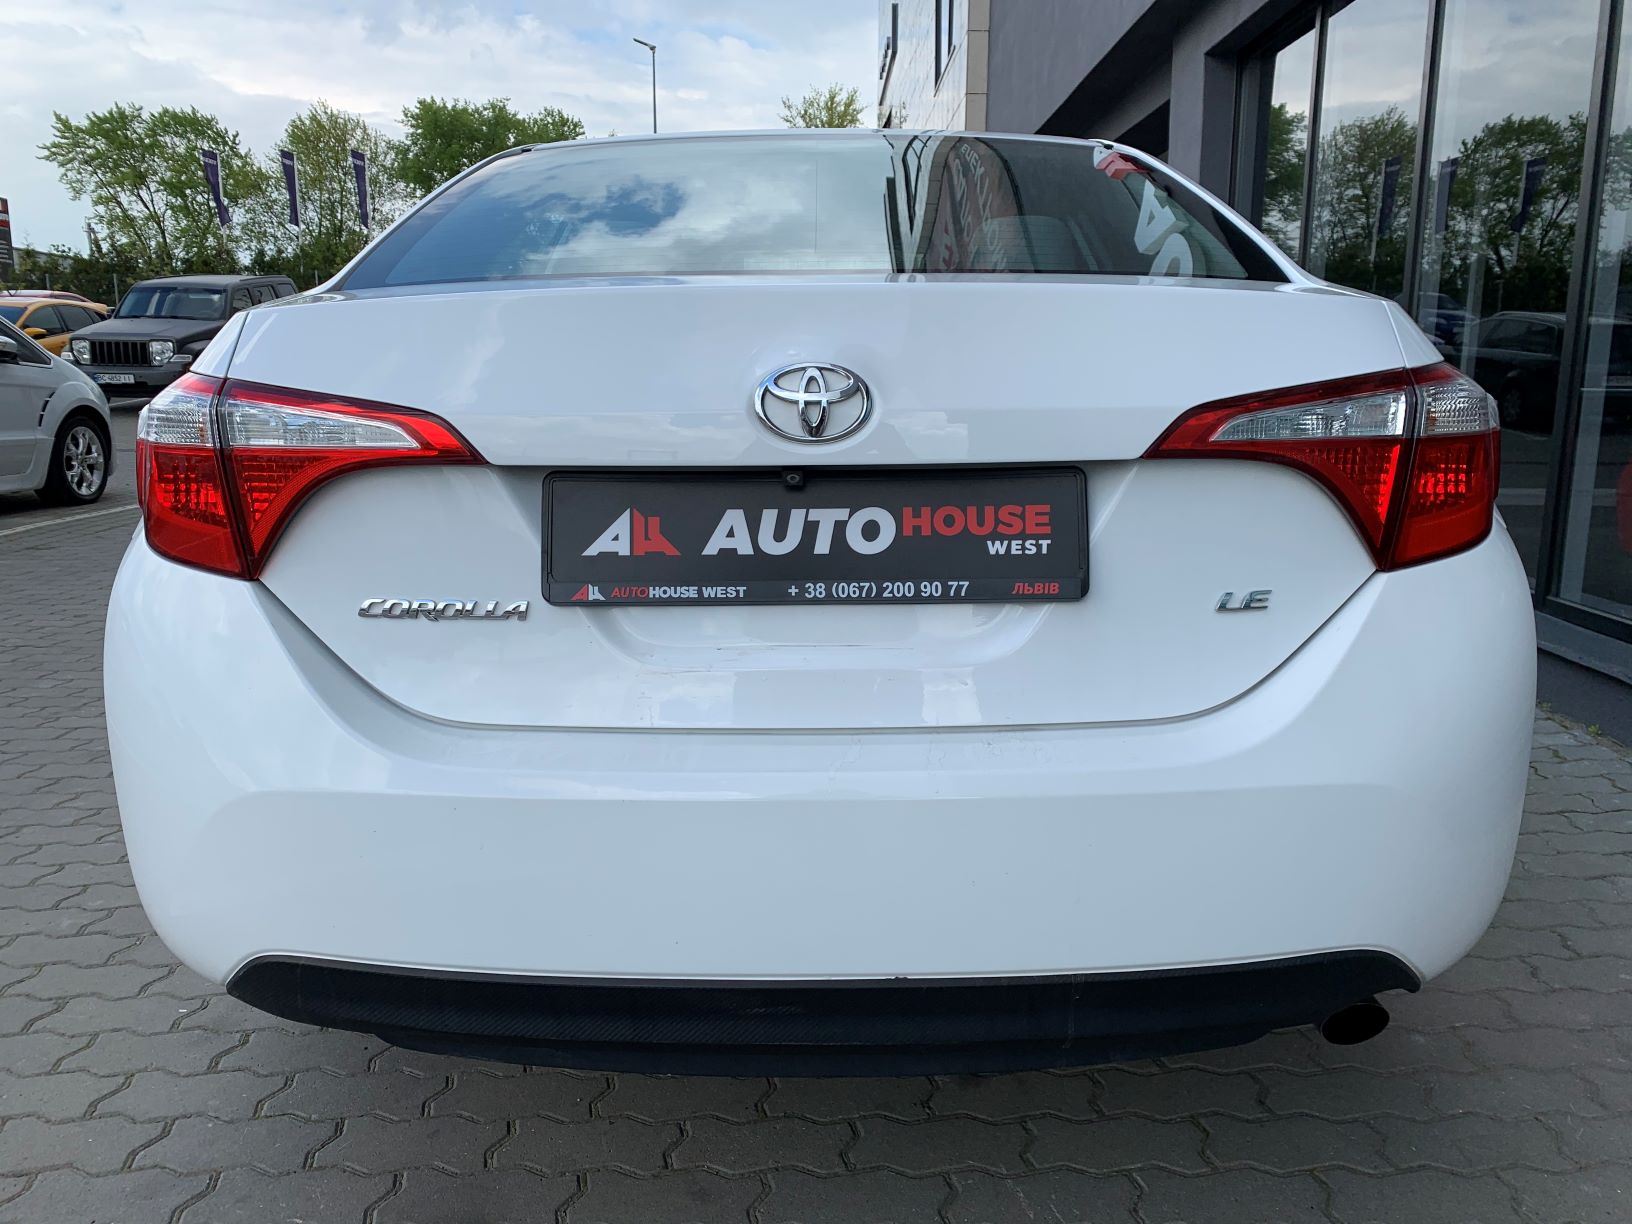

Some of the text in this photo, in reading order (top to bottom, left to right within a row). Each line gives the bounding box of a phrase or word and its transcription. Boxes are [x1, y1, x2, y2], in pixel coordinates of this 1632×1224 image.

[986, 539, 1052, 556] WEST
[702, 586, 747, 598] WEST
[804, 582, 826, 598] 38
[831, 582, 877, 598] (067)
[882, 581, 915, 598] 200
[920, 581, 942, 597] 90
[947, 581, 970, 597] 77
[1011, 582, 1061, 596] ЛЬВІВ
[357, 597, 530, 622] COROLLA
[1215, 589, 1273, 613] LE
